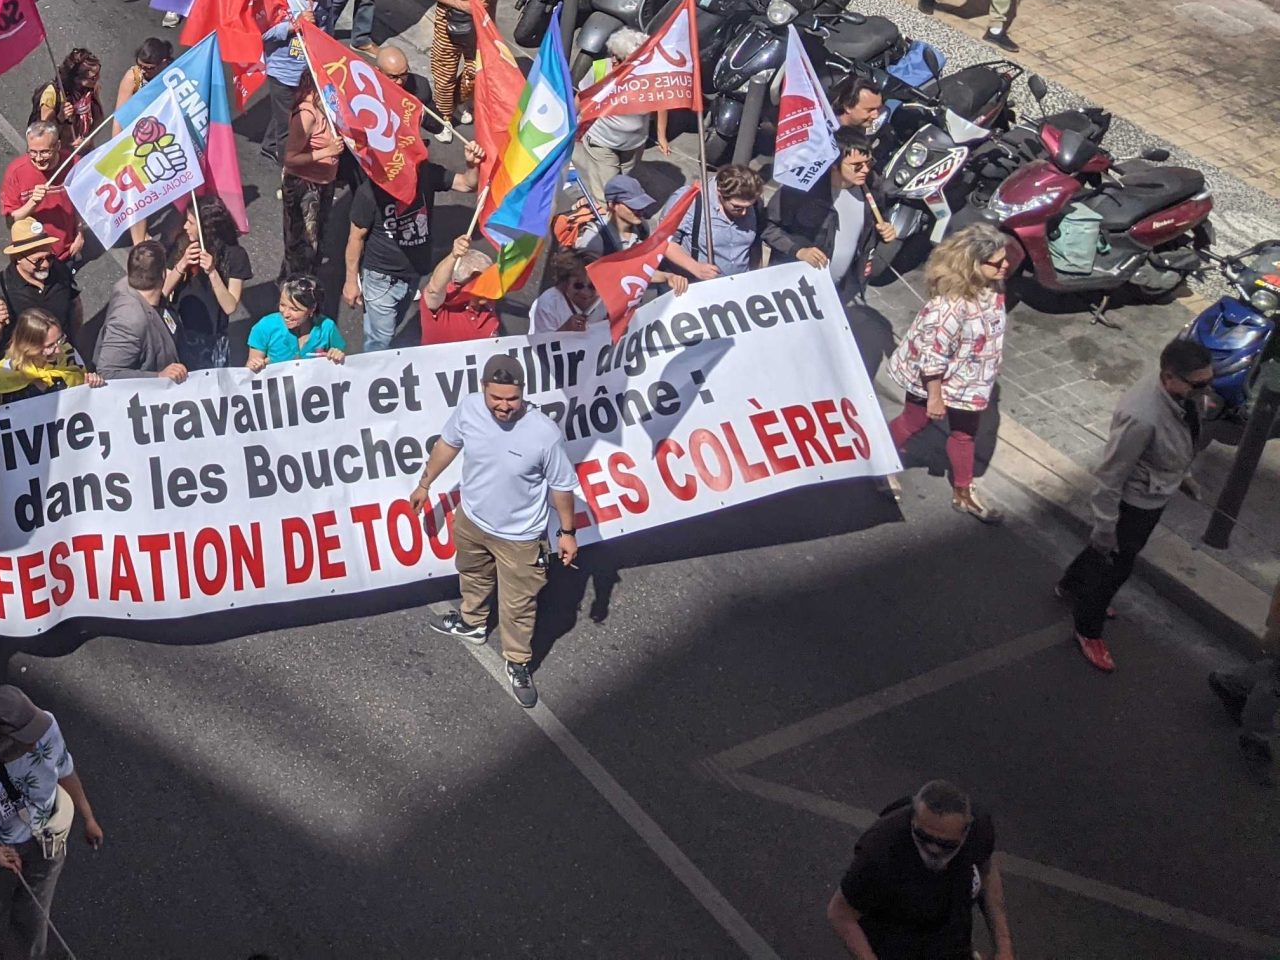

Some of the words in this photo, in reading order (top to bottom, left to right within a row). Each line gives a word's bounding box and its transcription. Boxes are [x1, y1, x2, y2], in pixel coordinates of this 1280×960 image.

[127, 375, 351, 446] travailler
[368, 362, 422, 415] et
[595, 274, 824, 377] dignement
[14, 472, 133, 533] dans
[149, 456, 228, 510] les
[282, 509, 347, 585] DE
[350, 489, 461, 572] TOU
[656, 396, 872, 503] COLÈRES
